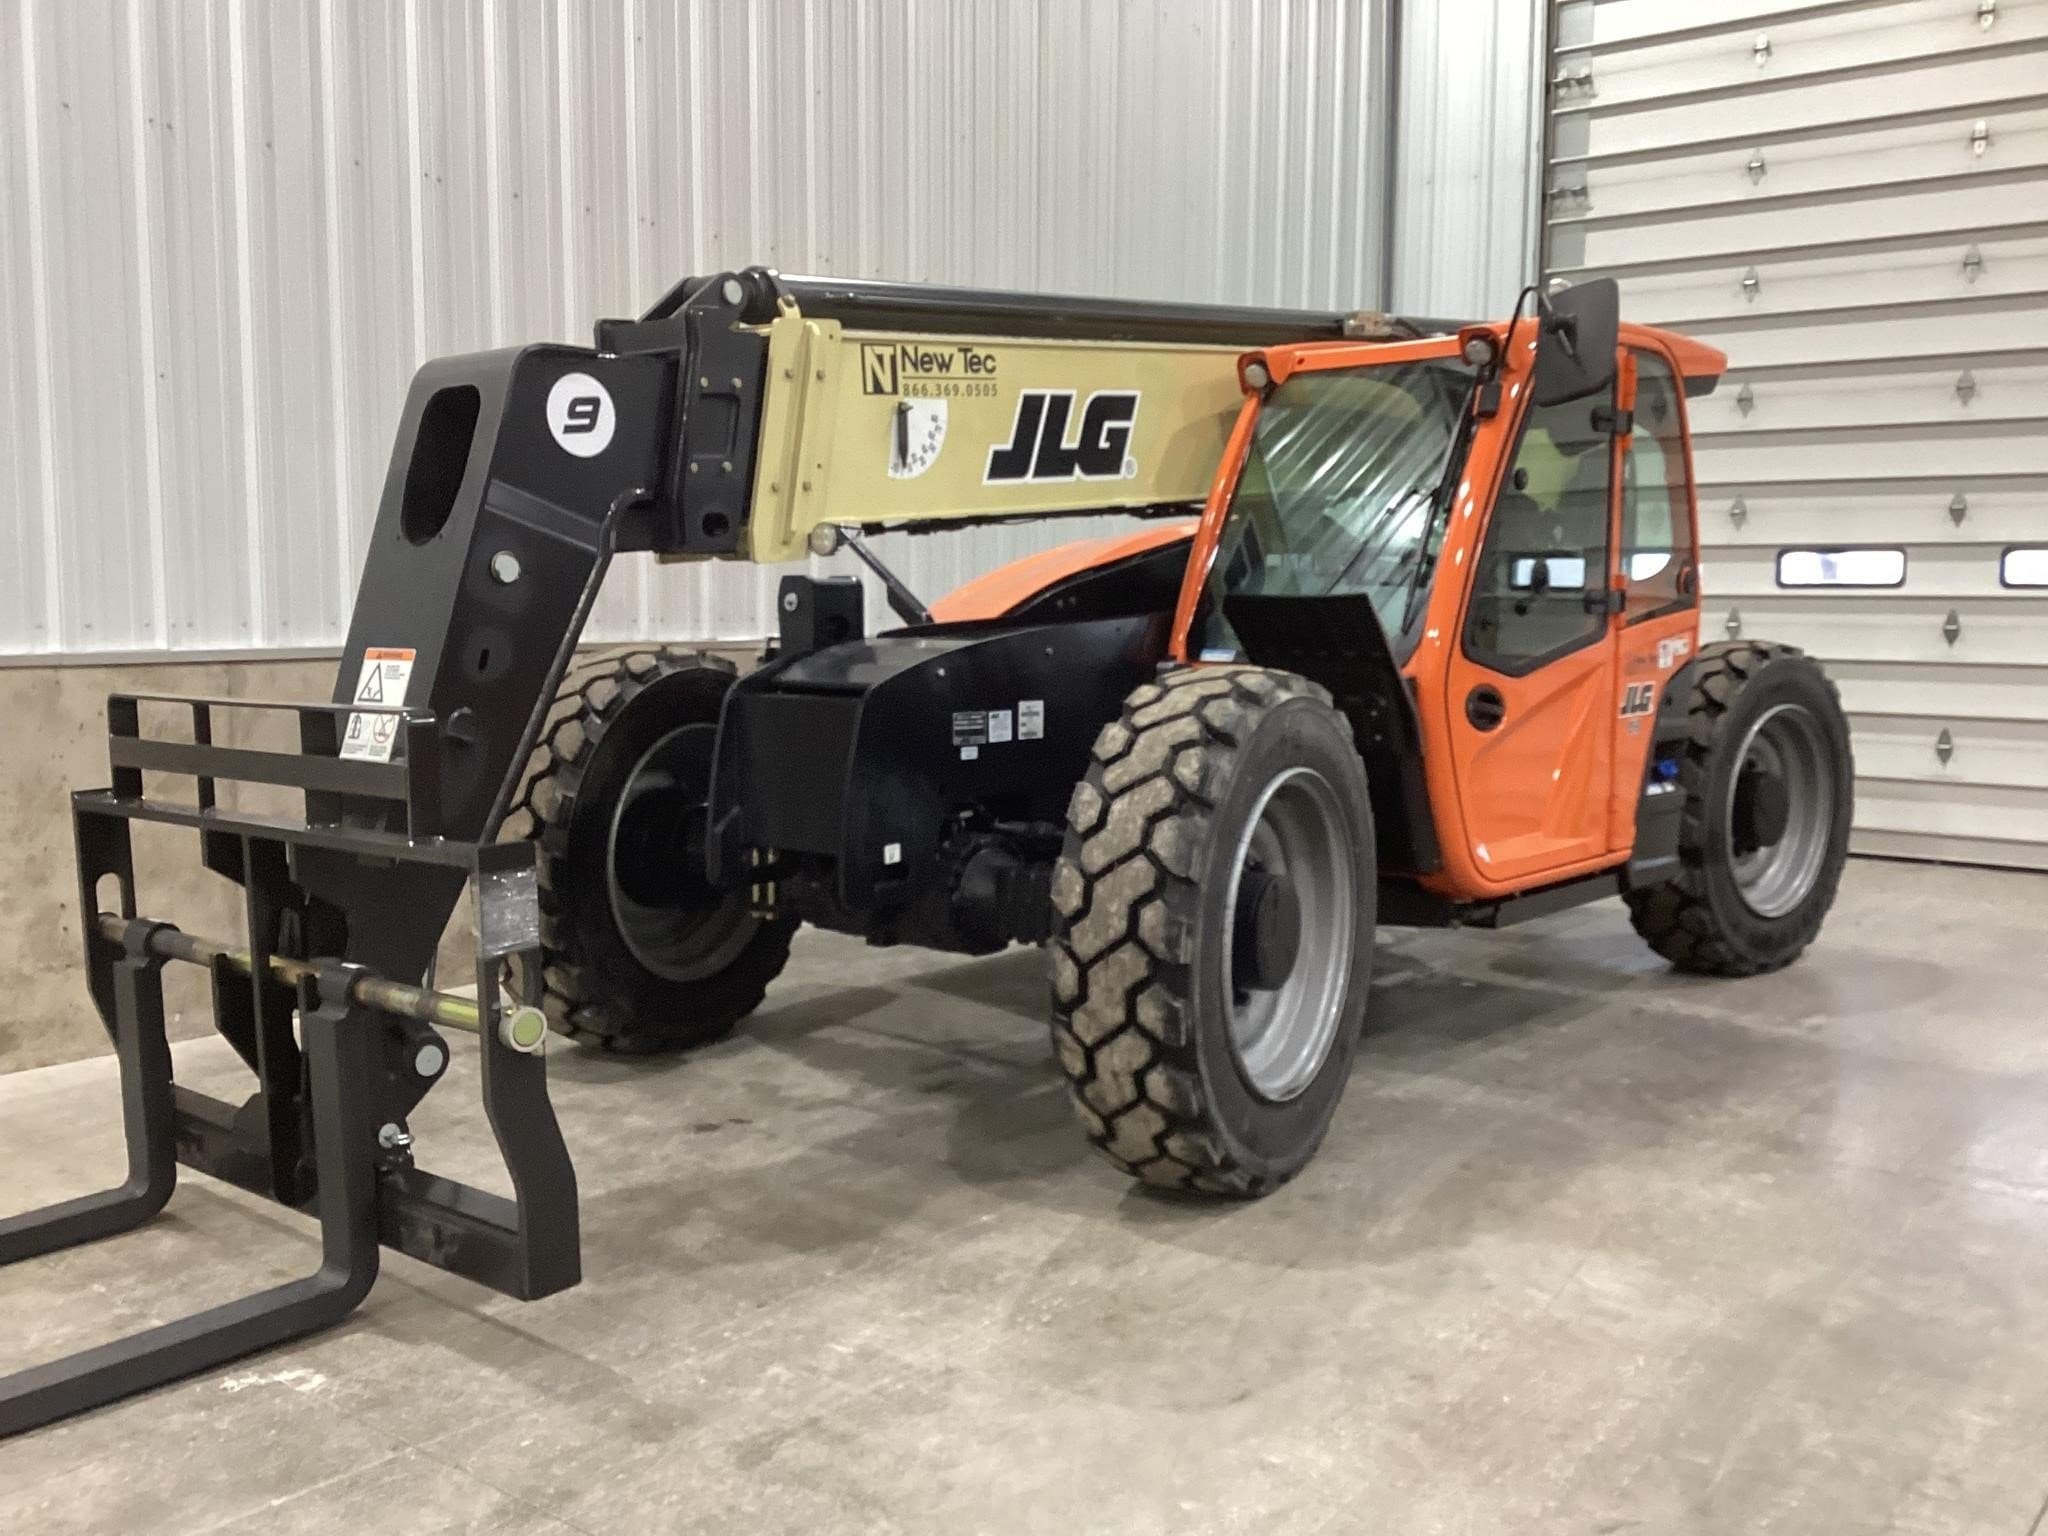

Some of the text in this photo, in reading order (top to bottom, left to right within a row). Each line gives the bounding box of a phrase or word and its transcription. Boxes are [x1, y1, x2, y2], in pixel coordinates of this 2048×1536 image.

[901, 345, 997, 374] New Tec
[903, 383, 998, 397] 866.369.0505
[562, 396, 601, 434] 9
[986, 392, 1138, 480] JLG
[1620, 684, 1654, 715] JLG
